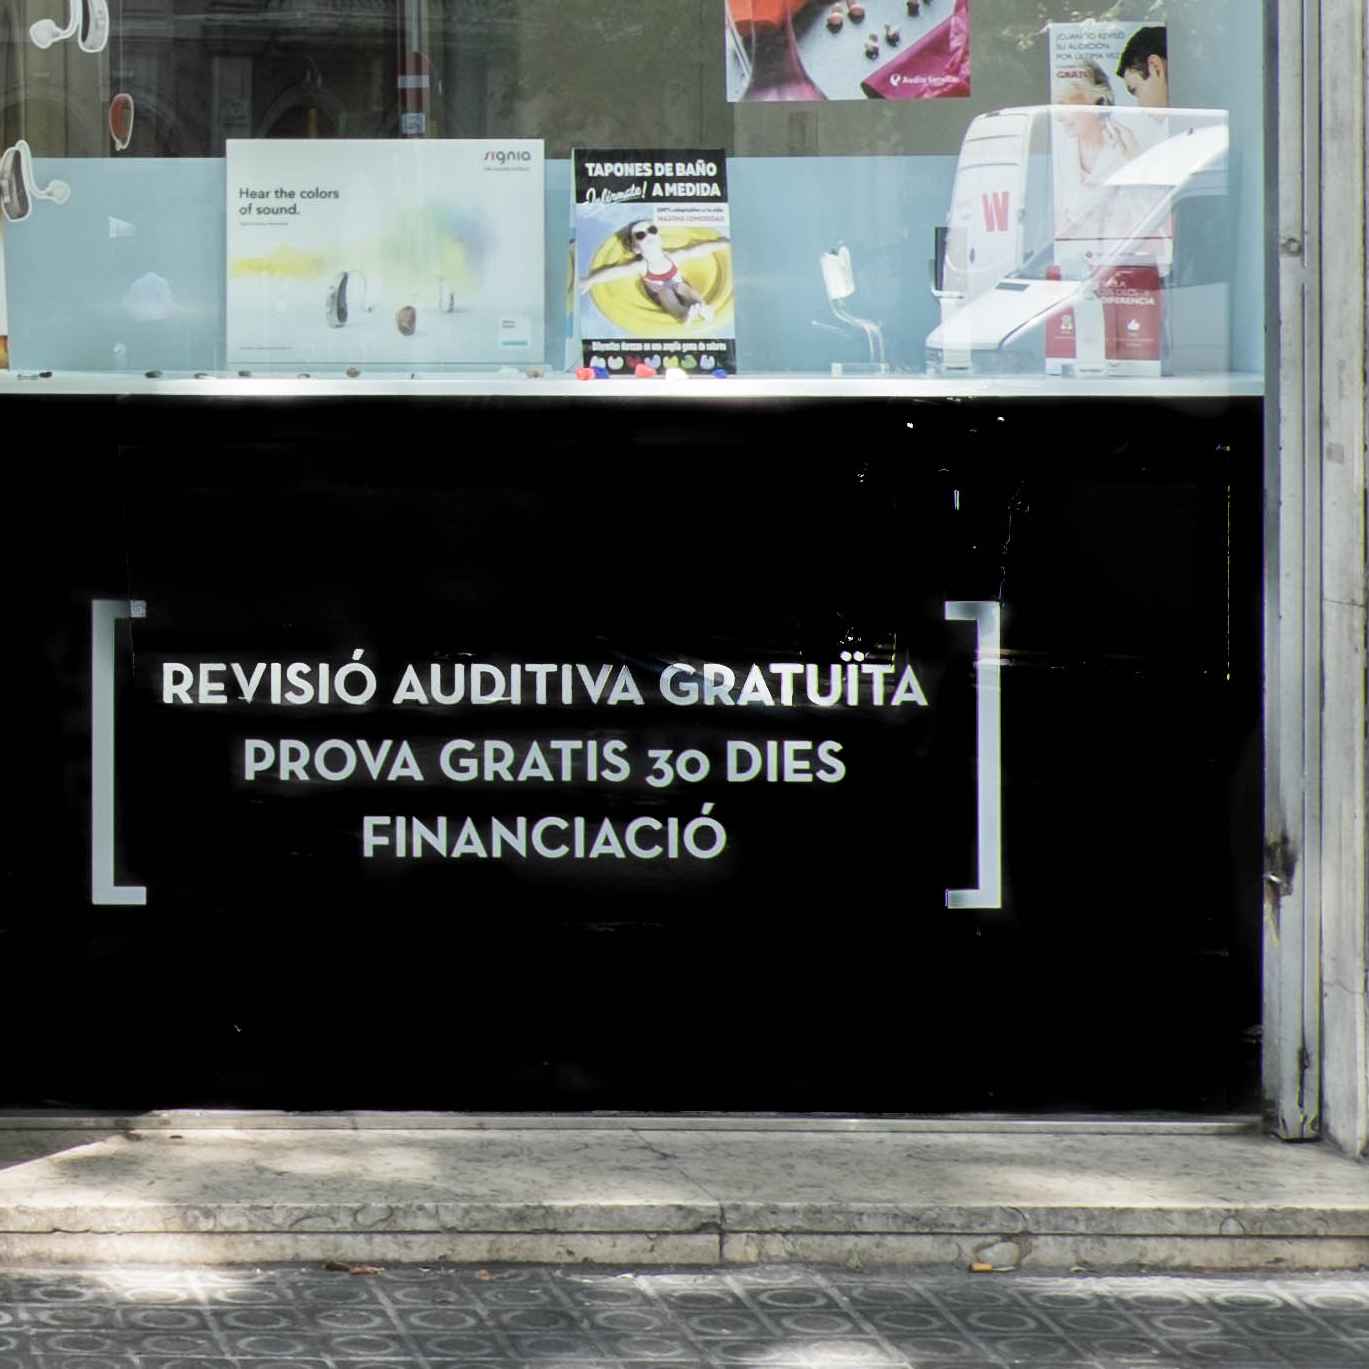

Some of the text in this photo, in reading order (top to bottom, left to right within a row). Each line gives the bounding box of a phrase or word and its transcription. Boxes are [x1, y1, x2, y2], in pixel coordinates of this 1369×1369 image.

[483, 151, 532, 165] signia
[585, 159, 717, 177] TAPONES DE BAÑO
[239, 187, 340, 199] Hear the colors
[651, 182, 721, 197] A MEDIDA
[239, 203, 301, 215] of sound.
[163, 649, 928, 708] REVISIÓ AUDITIVA GRATUÏTA
[245, 739, 845, 787] PROVA GRATIS 30 DIES
[363, 803, 727, 859] FINANCIACIÓ
